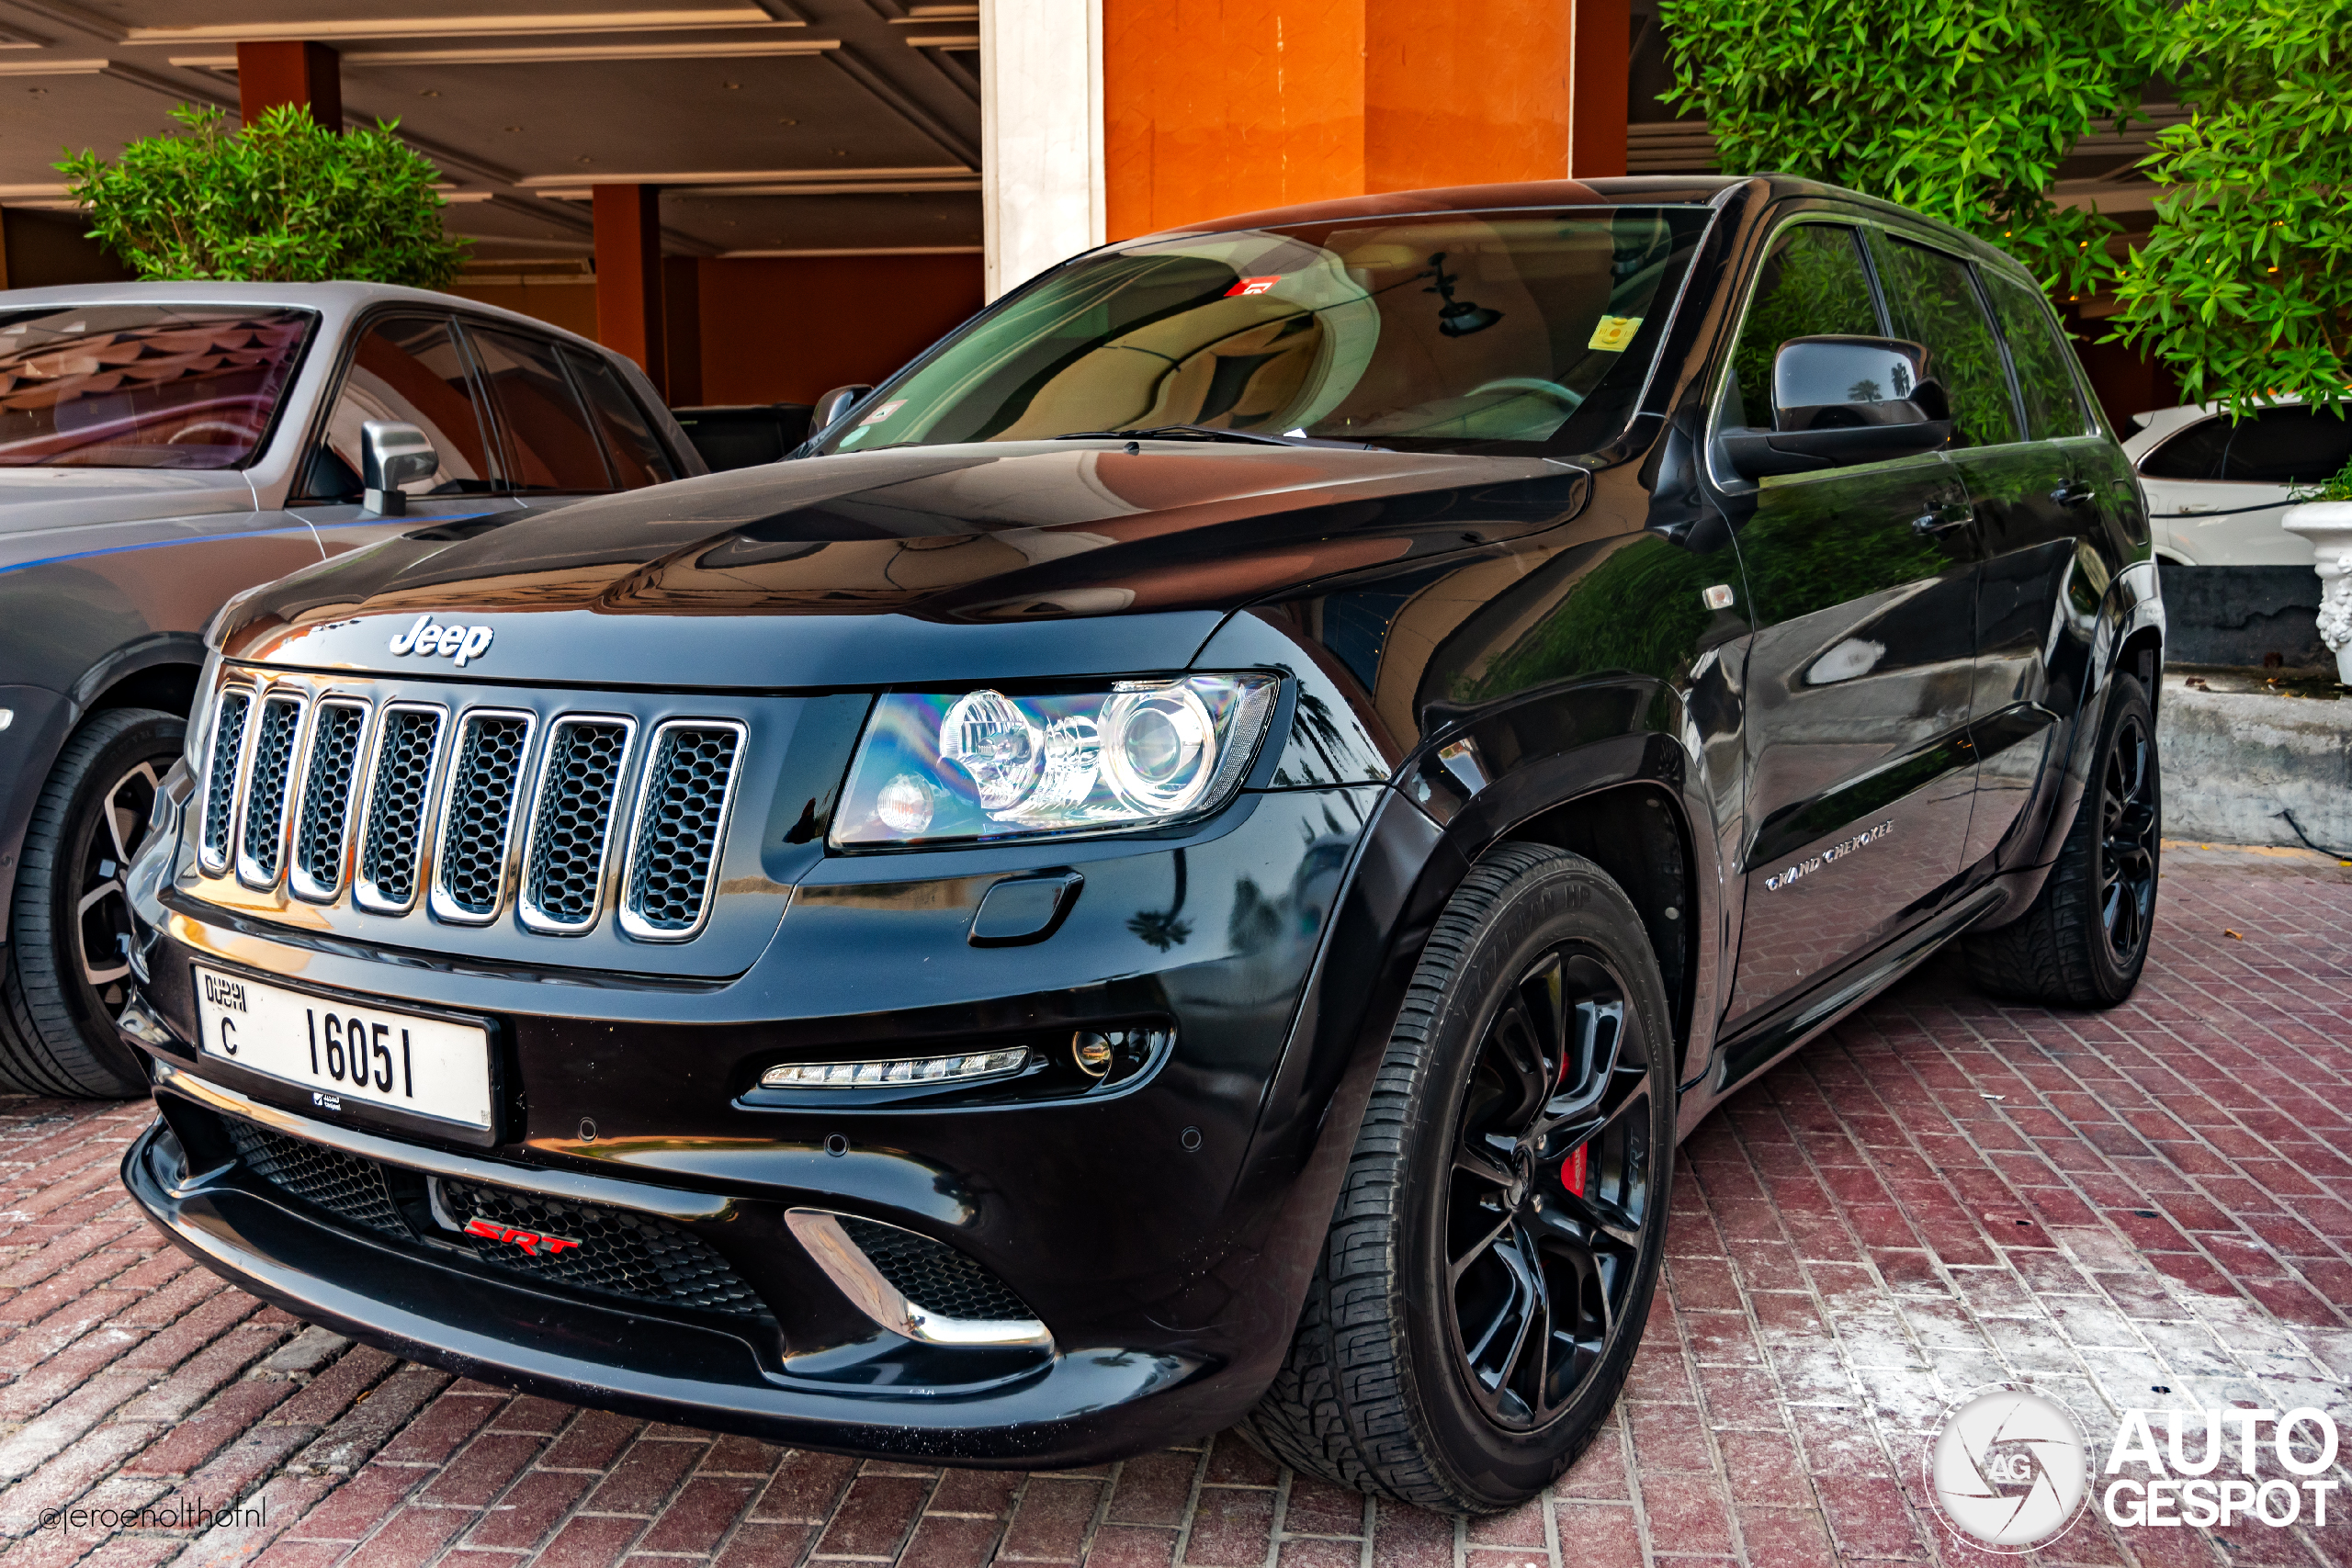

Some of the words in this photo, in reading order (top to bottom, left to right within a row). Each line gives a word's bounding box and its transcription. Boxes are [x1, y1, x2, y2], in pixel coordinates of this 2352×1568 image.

[389, 615, 494, 668] Jeep
[1765, 856, 1821, 892] GRAND
[1822, 818, 1894, 864] CHEROKEE
[221, 1016, 238, 1056] C
[306, 1007, 413, 1099] 16051
[1574, 1147, 1582, 1190] embo
[1628, 1126, 1644, 1190] SRT
[463, 1217, 581, 1257] SRT
